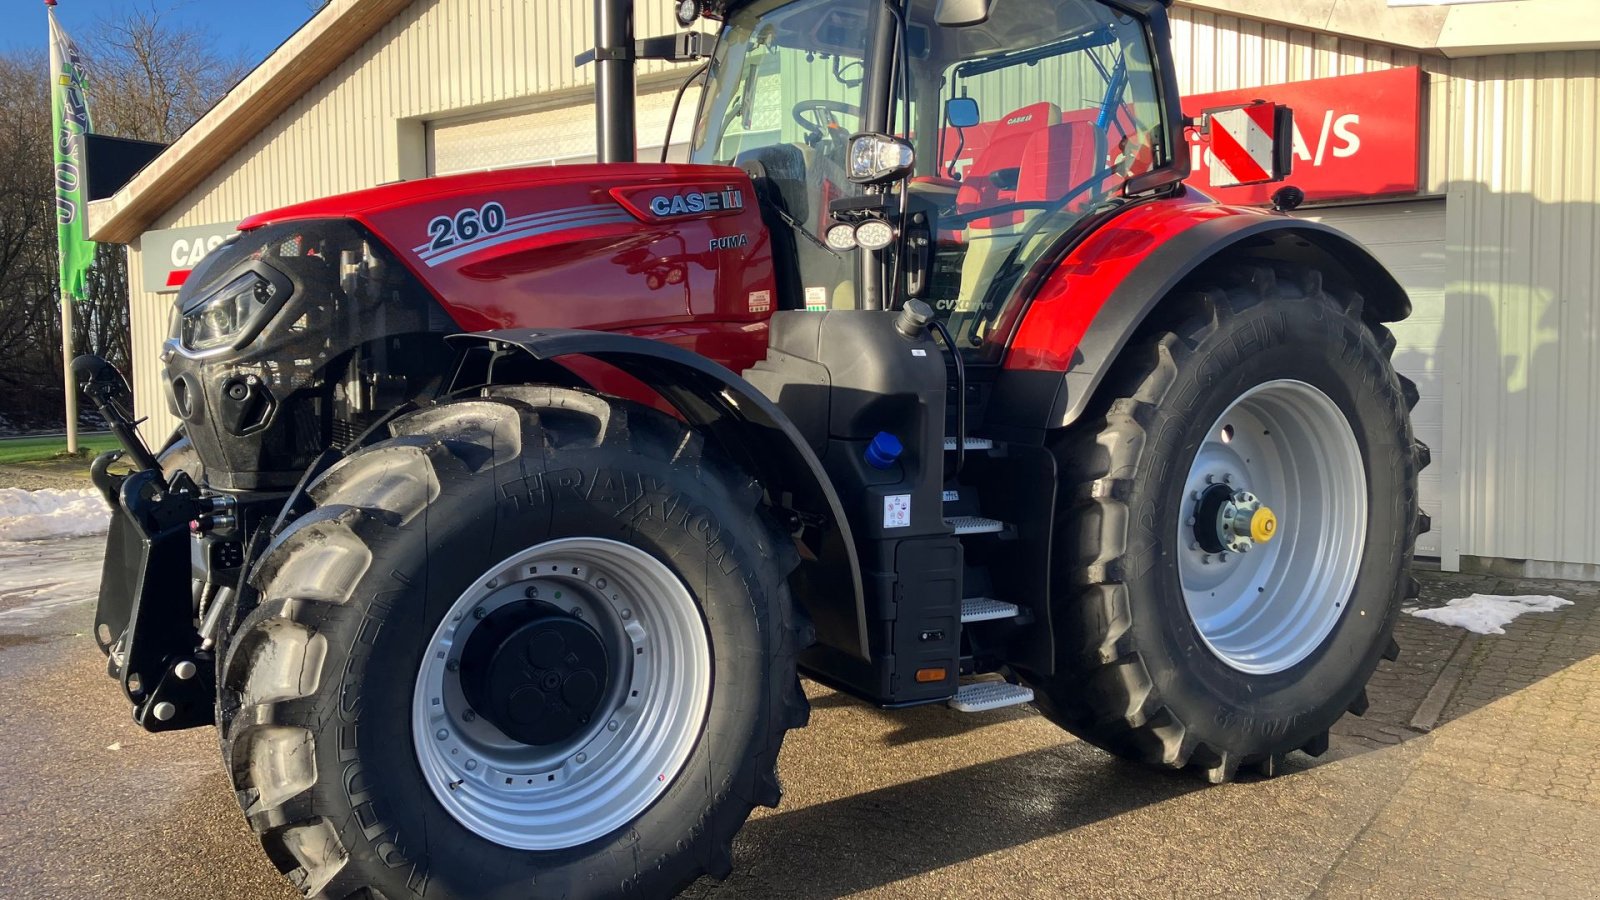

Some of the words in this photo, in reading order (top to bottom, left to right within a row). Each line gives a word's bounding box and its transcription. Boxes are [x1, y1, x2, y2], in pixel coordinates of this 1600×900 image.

[650, 192, 719, 216] CASE
[427, 201, 506, 251] 260
[171, 233, 240, 267] CAS
[709, 234, 748, 252] PUMA
